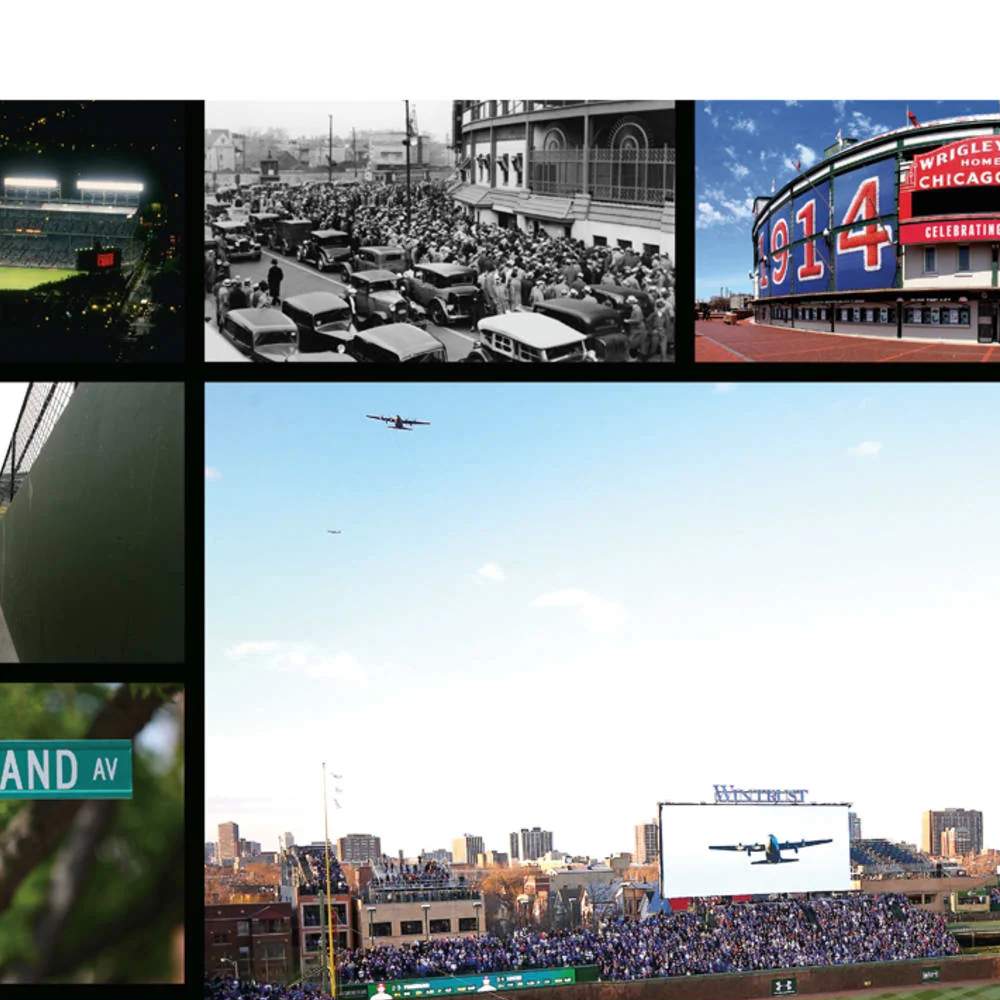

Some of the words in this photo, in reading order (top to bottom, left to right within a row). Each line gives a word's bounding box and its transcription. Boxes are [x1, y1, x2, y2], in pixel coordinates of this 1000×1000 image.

[758, 176, 893, 289] 1914
[0, 750, 78, 790] AND
[93, 757, 118, 780] AV
[712, 784, 809, 802] WINTRUST
